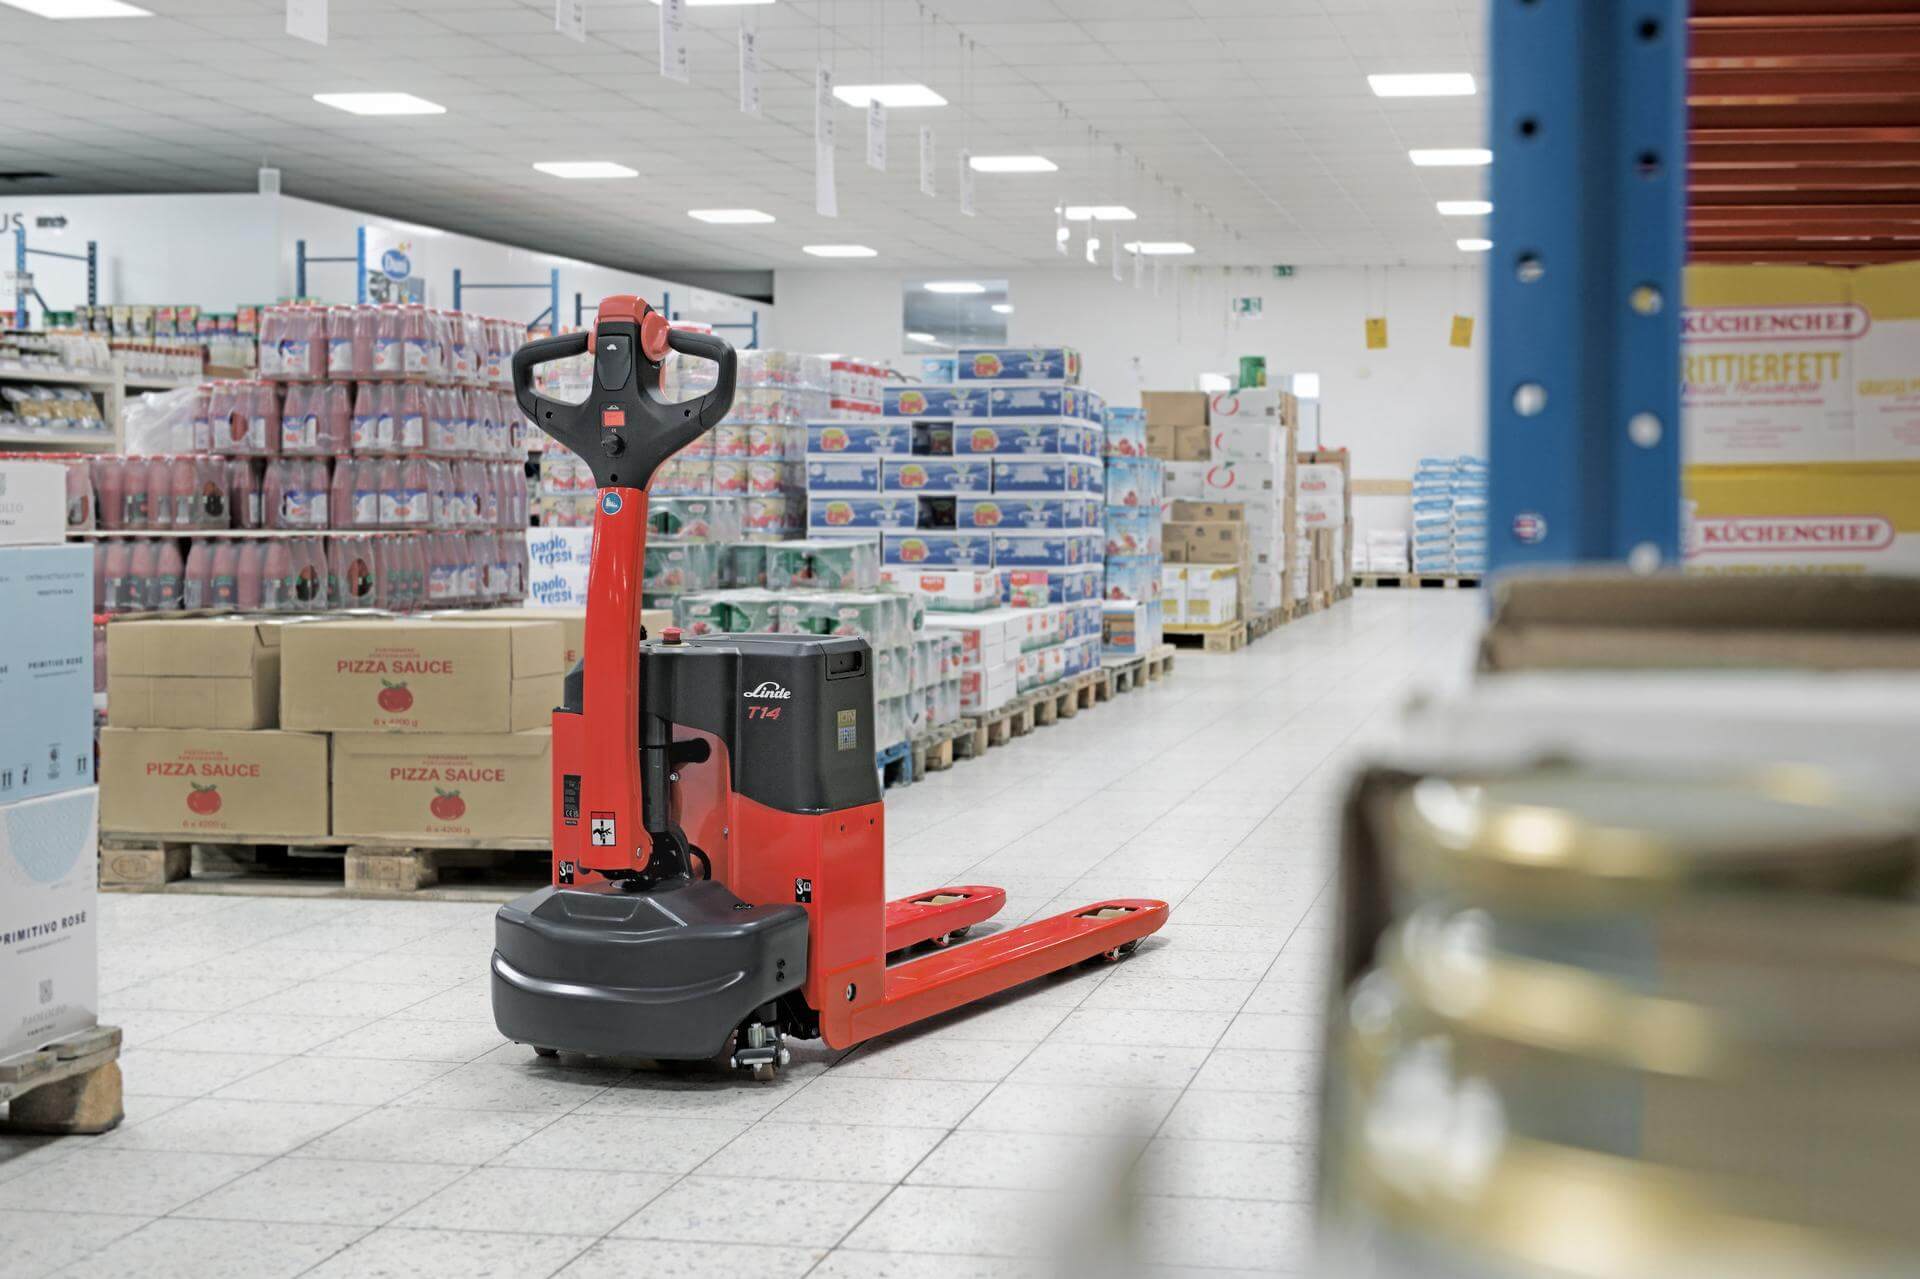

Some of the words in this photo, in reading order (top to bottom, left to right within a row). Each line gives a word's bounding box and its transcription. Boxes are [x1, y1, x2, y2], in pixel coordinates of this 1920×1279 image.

[1703, 521, 1880, 544] KÜCHENCHEF
[531, 535, 567, 559] paolo
[539, 547, 572, 565] rossi
[532, 575, 567, 599] paolo
[541, 587, 572, 604] rossi
[337, 660, 388, 674] PIZZA
[392, 660, 453, 674] SAUCE
[743, 681, 791, 699] Linde
[748, 706, 781, 720] T14
[146, 763, 196, 776] PIZZA
[201, 763, 260, 777] SAUCE
[390, 768, 440, 781] PIZZA
[445, 768, 505, 782] SAUCE
[62, 911, 86, 928] ROSÉ
